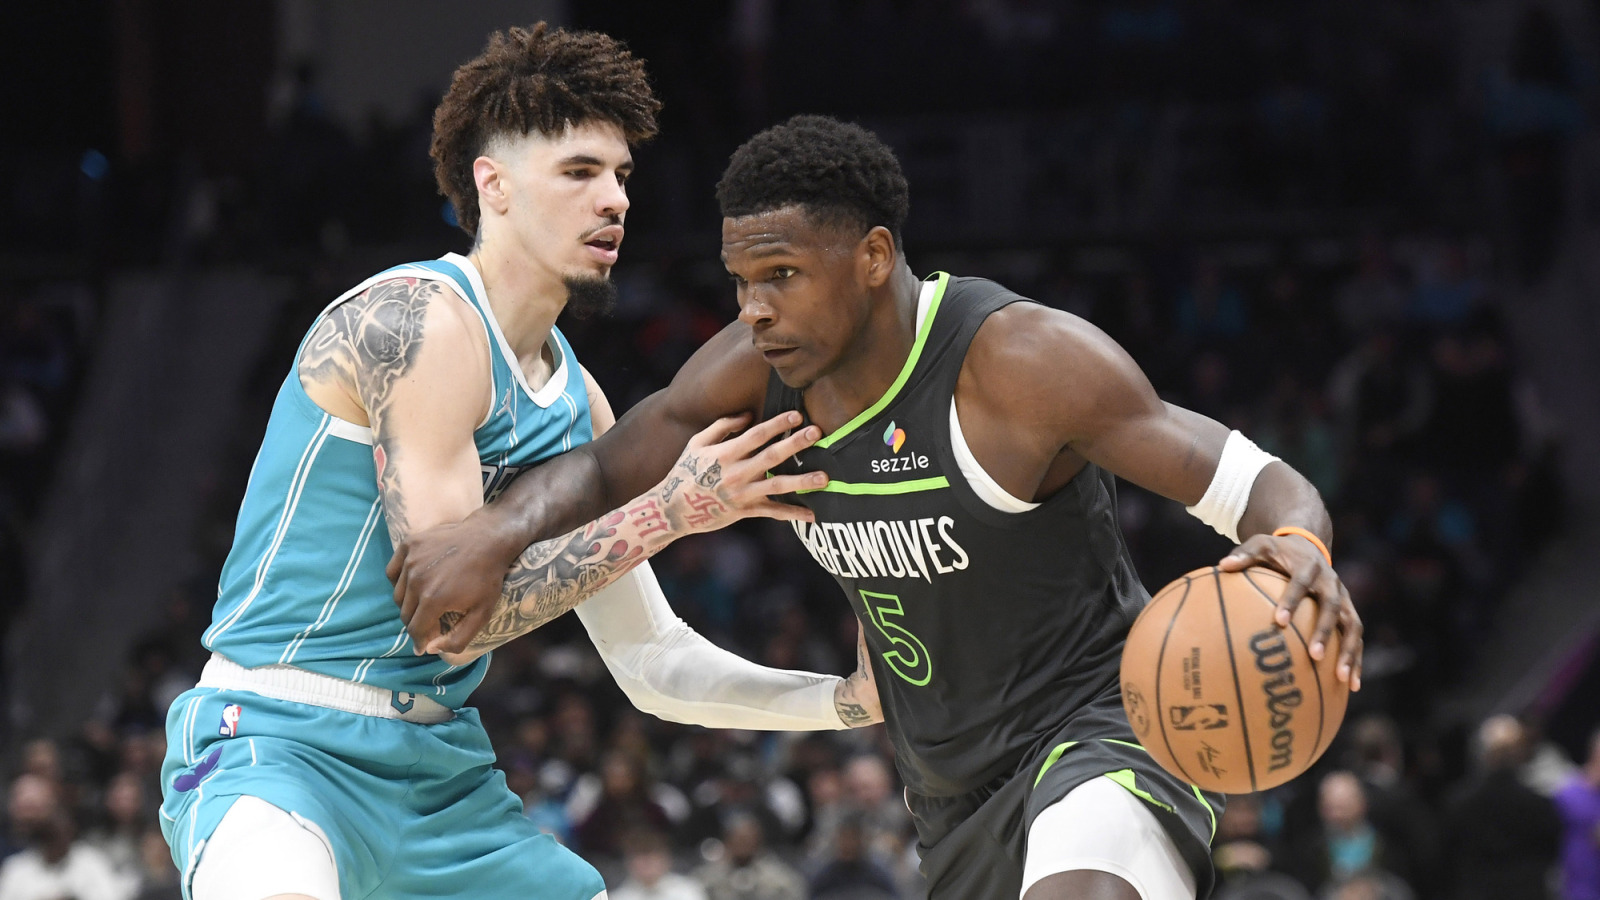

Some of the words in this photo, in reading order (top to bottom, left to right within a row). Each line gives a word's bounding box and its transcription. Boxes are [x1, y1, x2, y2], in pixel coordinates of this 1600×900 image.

[871, 451, 929, 473] sezzle
[859, 589, 932, 686] 5
[1250, 624, 1302, 774] Wilson
